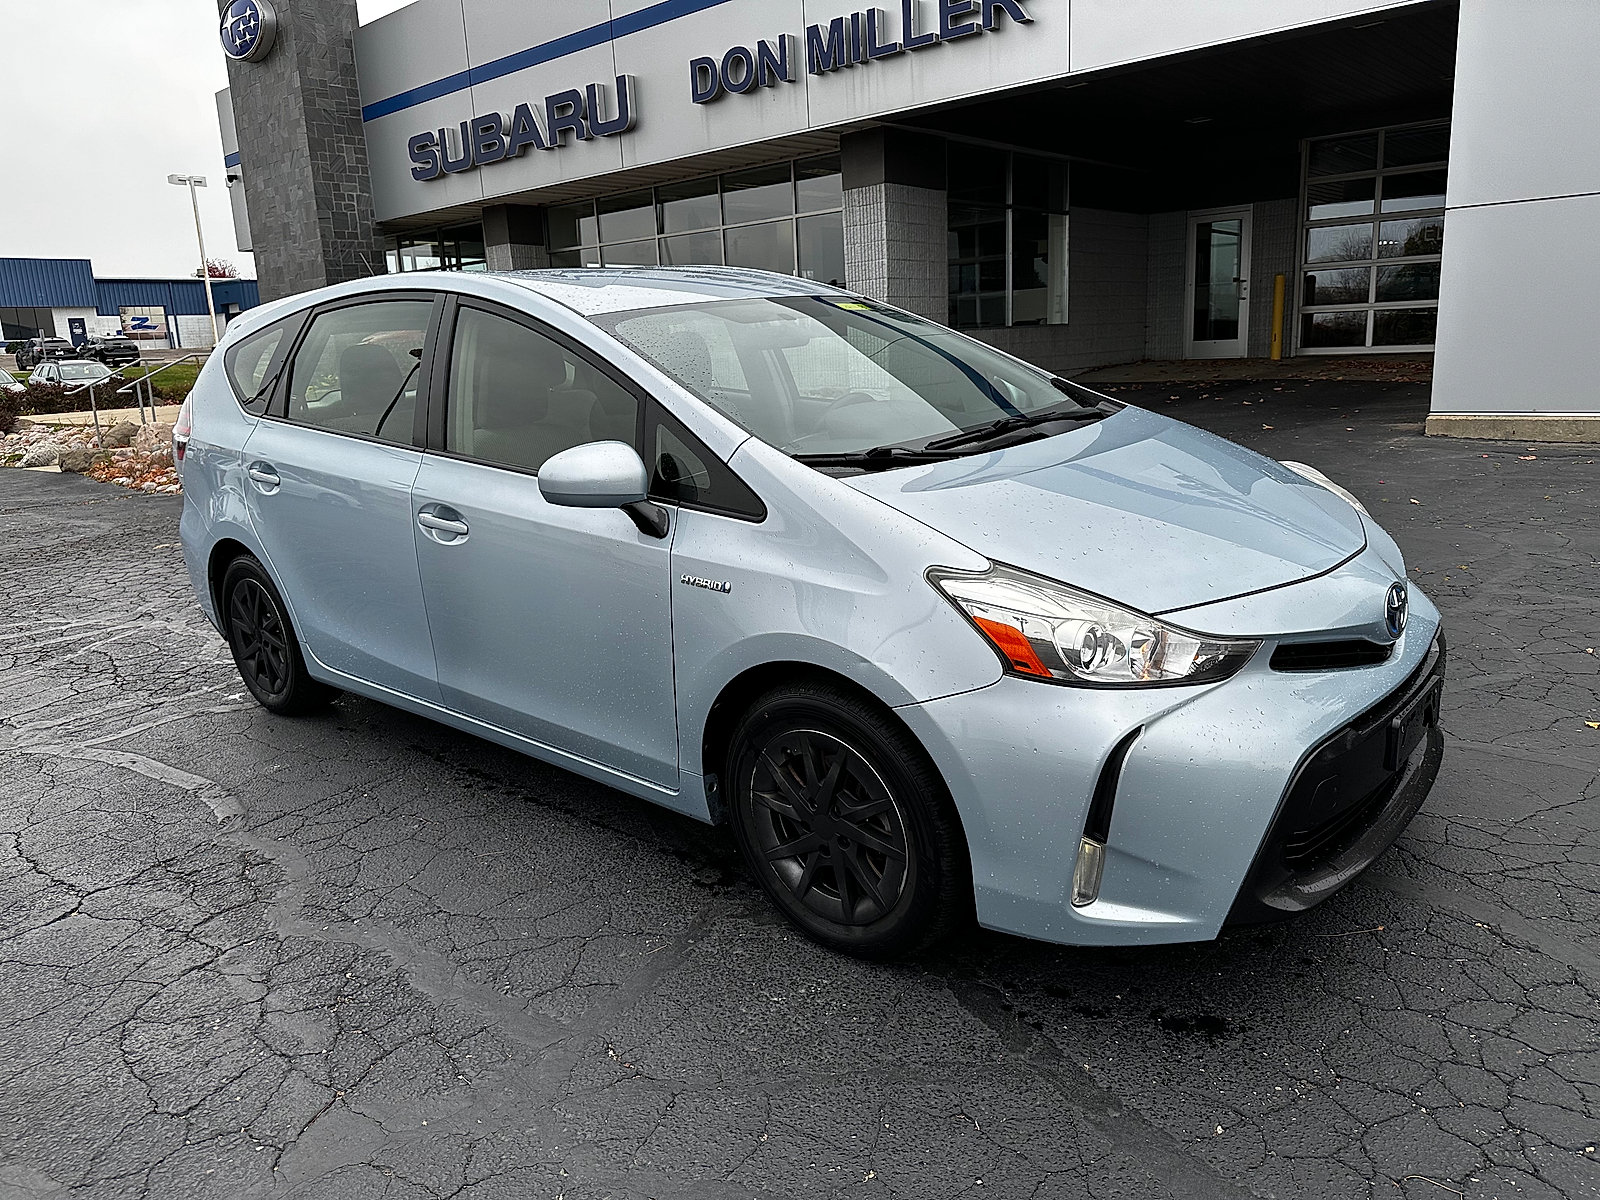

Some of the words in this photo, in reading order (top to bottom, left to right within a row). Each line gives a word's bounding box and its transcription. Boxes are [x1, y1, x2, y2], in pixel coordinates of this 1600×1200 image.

[690, 33, 795, 104] DON
[408, 74, 637, 181] SUBARU
[680, 574, 723, 592] HYBRID
